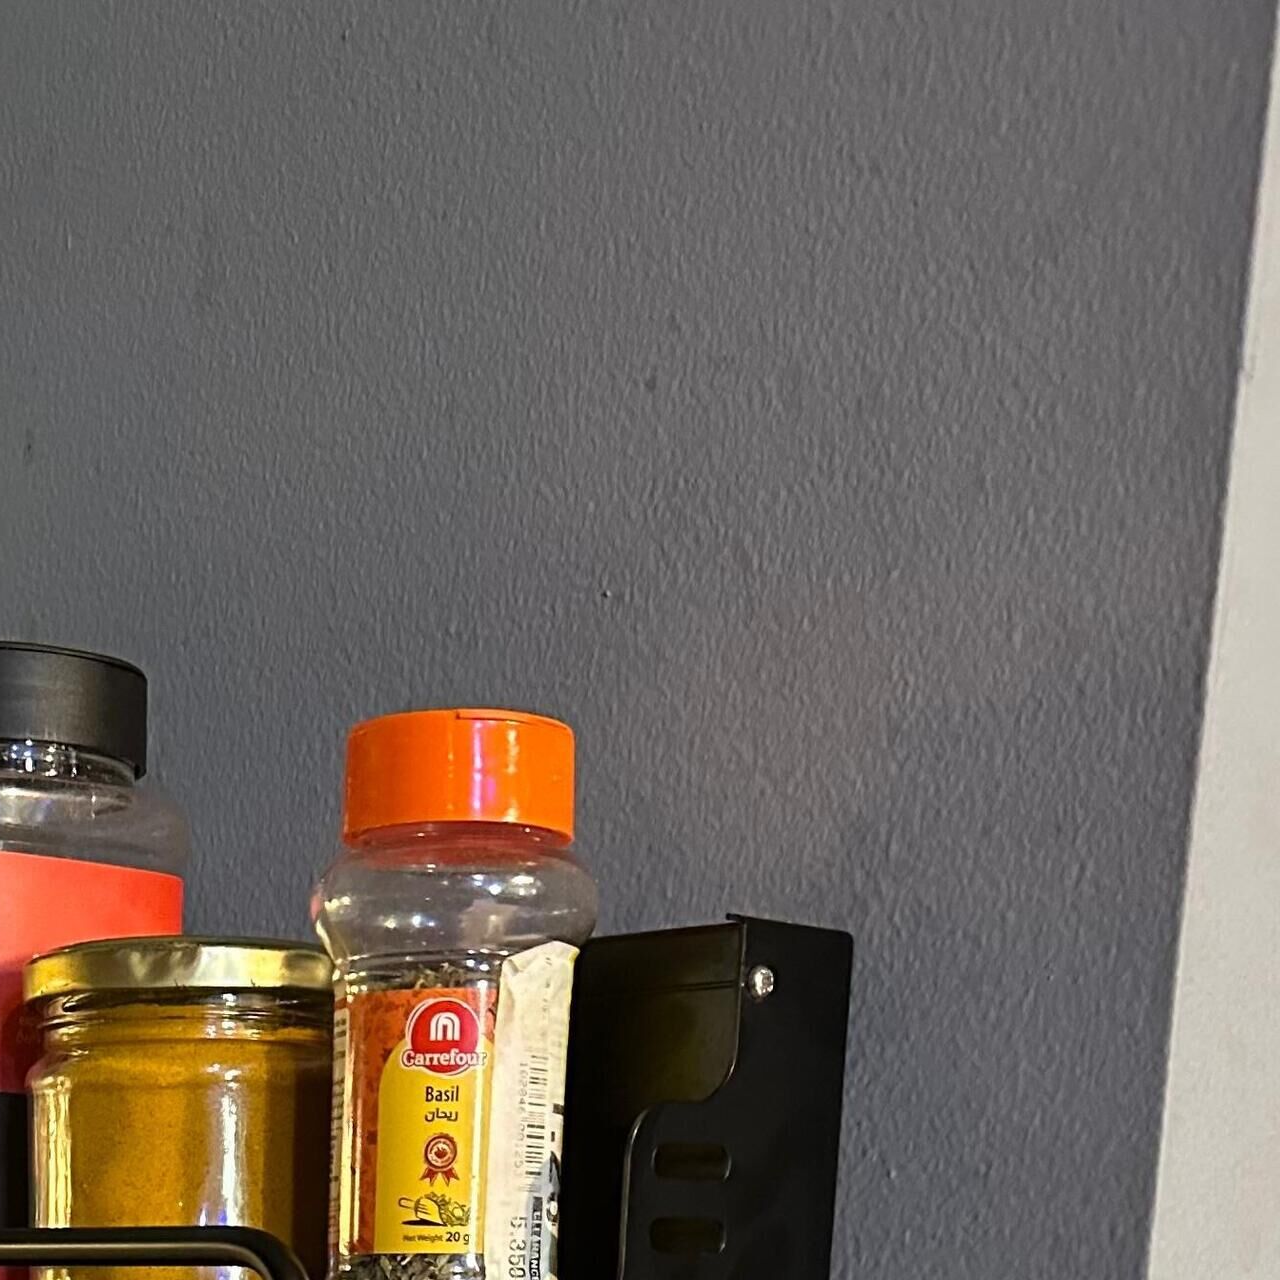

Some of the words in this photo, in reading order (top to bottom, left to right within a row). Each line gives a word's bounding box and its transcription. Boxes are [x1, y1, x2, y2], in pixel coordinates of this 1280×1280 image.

[402, 1048, 487, 1067] Carrefour
[425, 1085, 459, 1102] Basil
[424, 1107, 459, 1122] ريحان
[417, 1233, 443, 1243] Weight
[445, 1231, 460, 1243] 20
[463, 1233, 470, 1245] g
